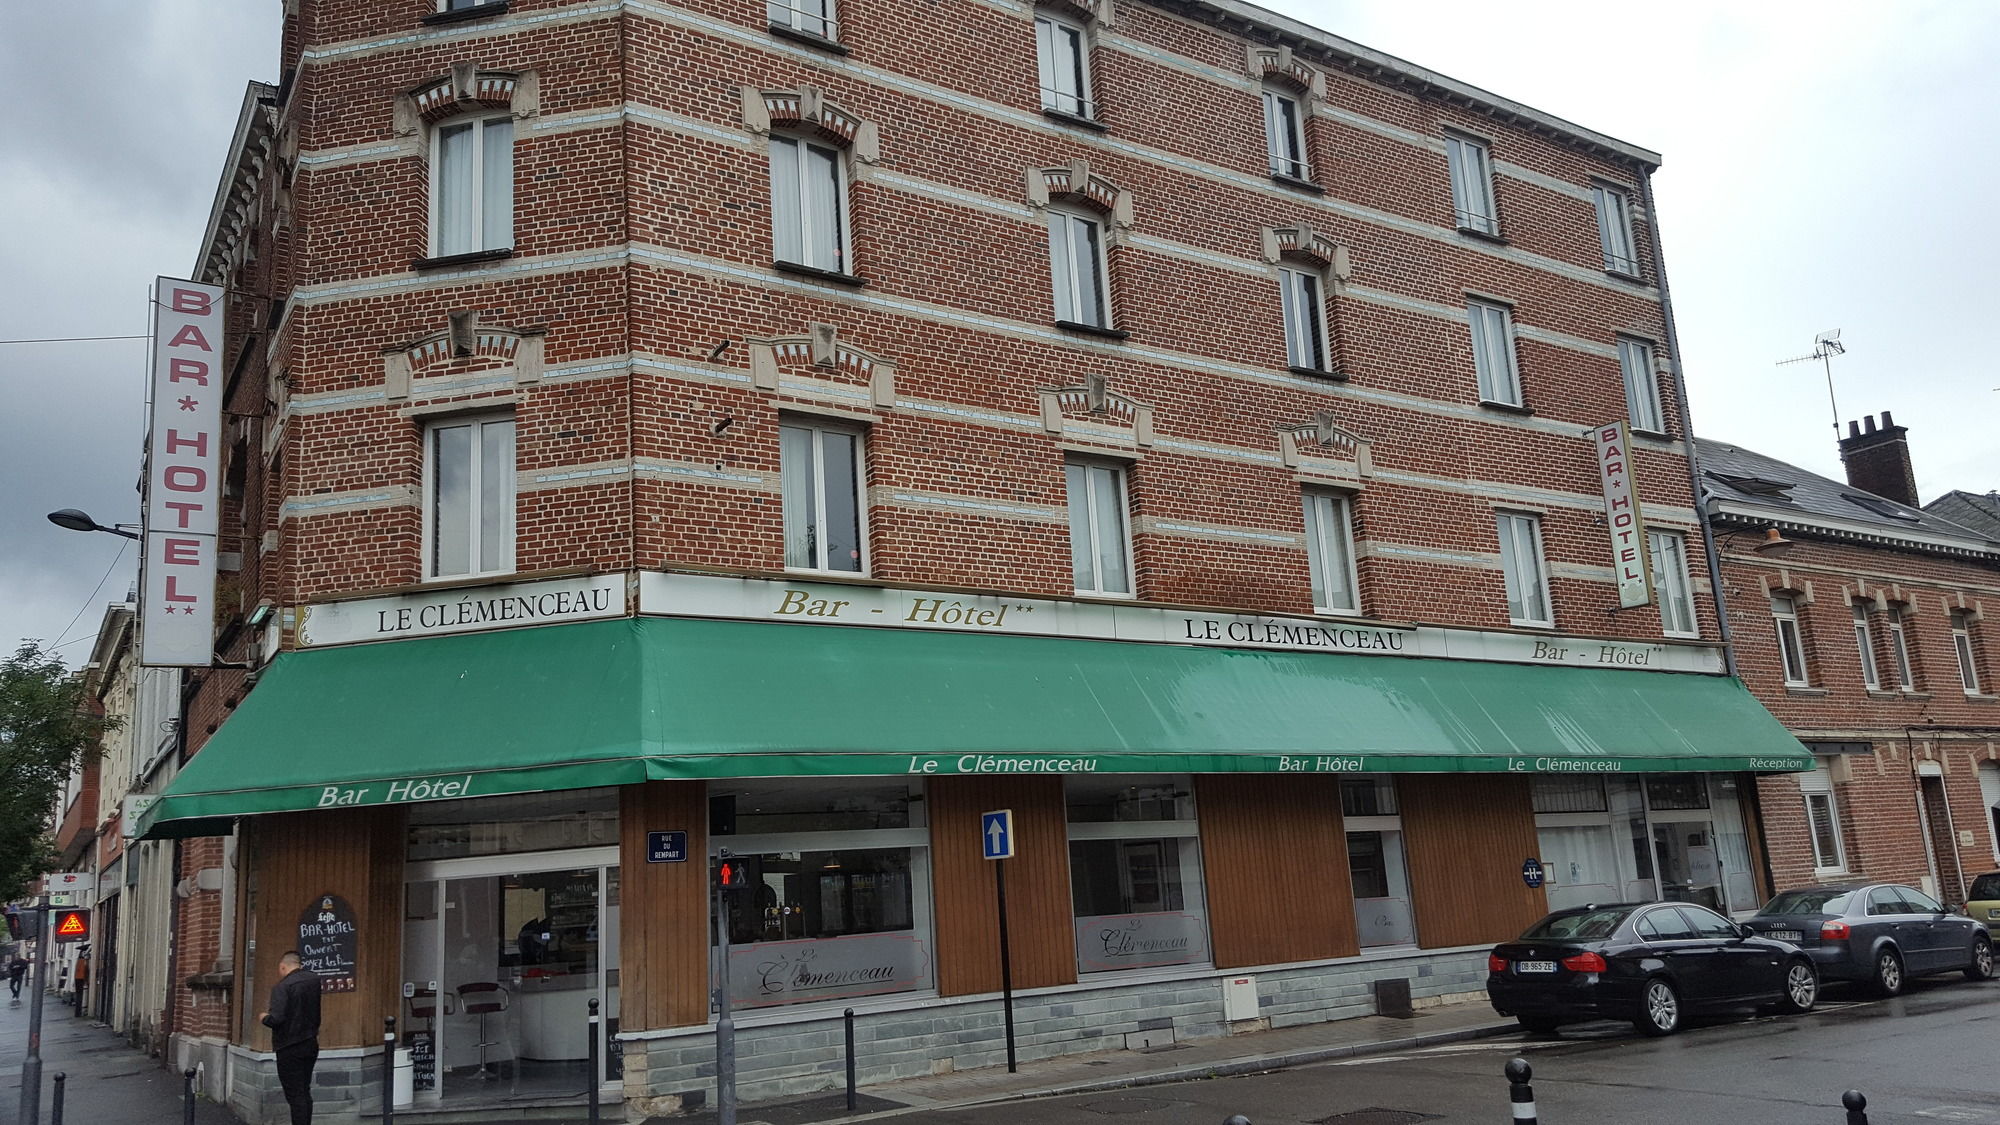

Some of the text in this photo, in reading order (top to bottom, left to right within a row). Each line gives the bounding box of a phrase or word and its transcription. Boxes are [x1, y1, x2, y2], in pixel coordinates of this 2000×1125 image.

[163, 288, 213, 603] BAR HOTEL
[1601, 427, 1639, 580] BAR HOTEL
[377, 588, 612, 633] LE CLÉMENCEAU
[773, 590, 850, 618] Bar
[904, 598, 1009, 627] Hôtel
[1183, 618, 1404, 651] LE CLÉMENCEAU
[1531, 641, 1569, 661] Bar
[1597, 645, 1651, 666] Hôtel
[908, 754, 1097, 774] Le Clémenceau
[1278, 756, 1364, 772] Bar Hôtel
[1508, 756, 1622, 771] Le Clémenceau
[1749, 757, 1804, 770] Réception
[317, 775, 473, 807] Bar Hôtel
[661, 834, 672, 842] RUE
[654, 850, 679, 859] REMPART
